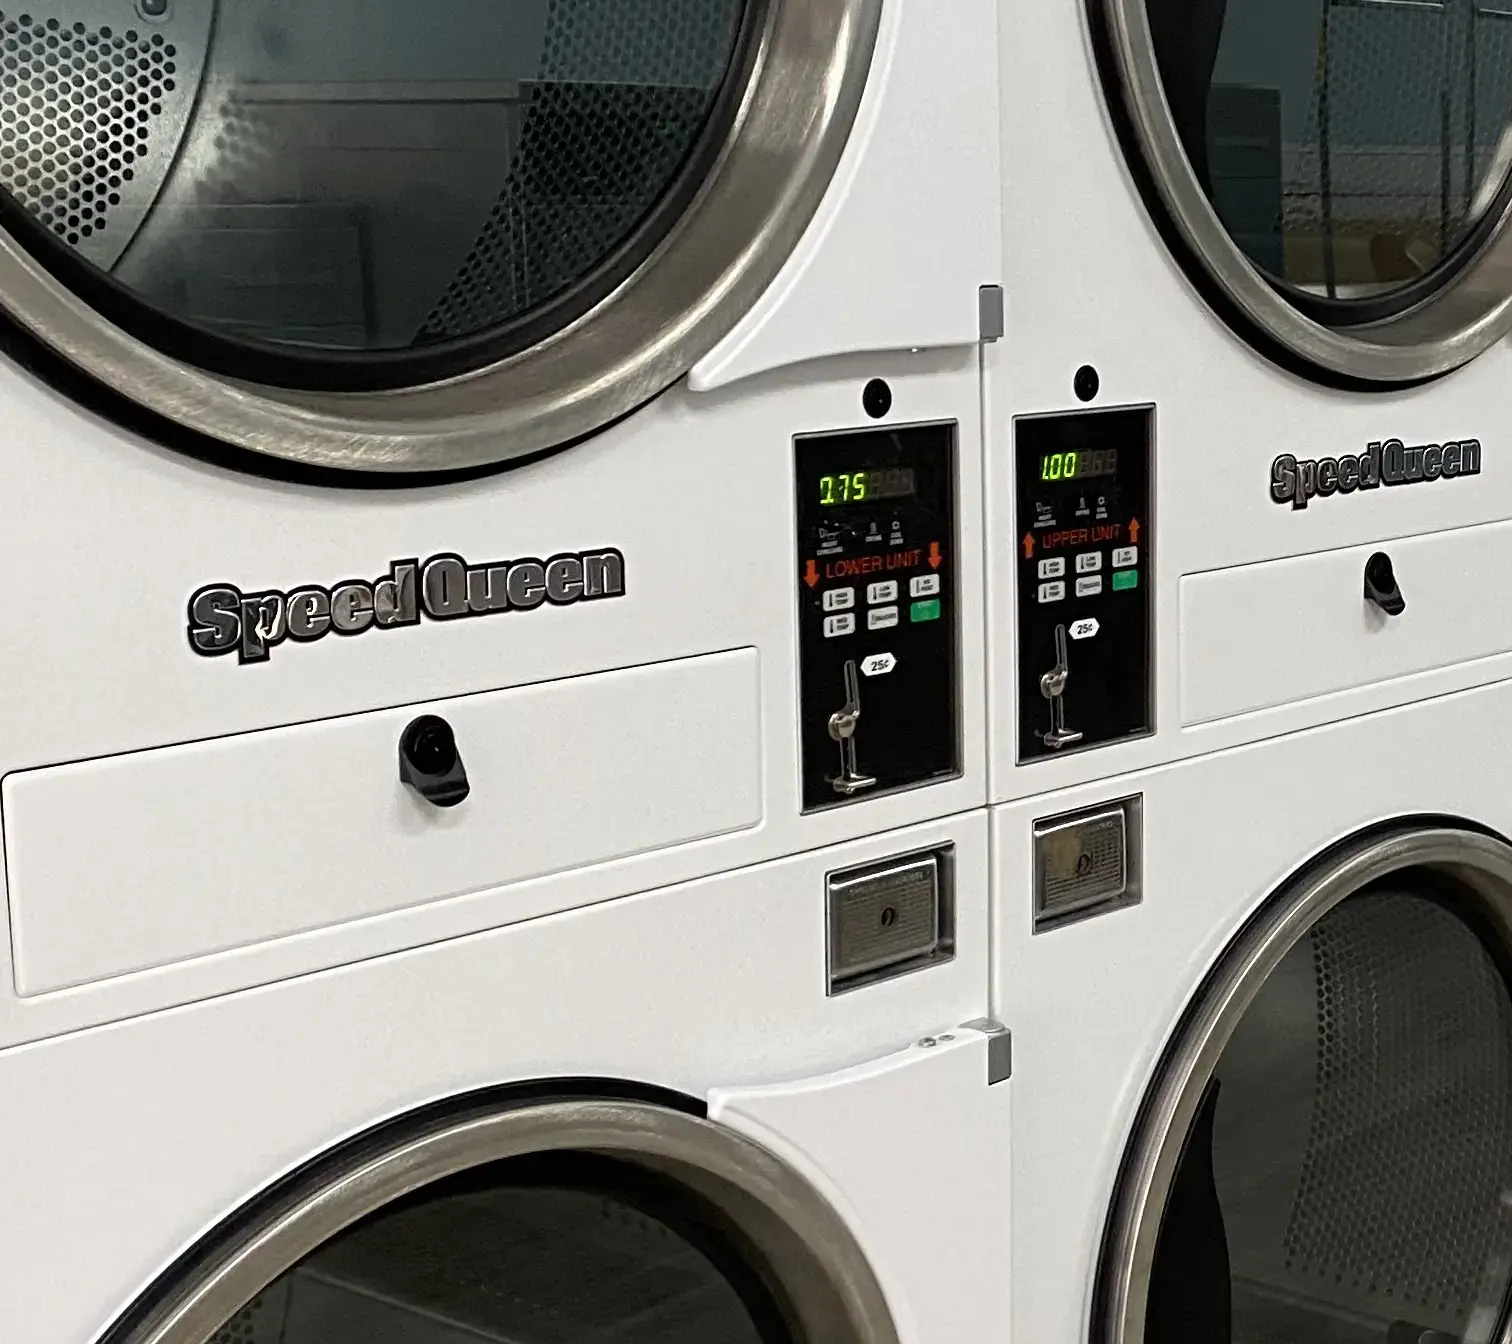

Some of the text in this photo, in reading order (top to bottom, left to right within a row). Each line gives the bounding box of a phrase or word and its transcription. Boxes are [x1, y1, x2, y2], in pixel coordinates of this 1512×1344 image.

[1042, 524, 1122, 549] UPPER UNIT
[825, 549, 924, 579] LOWER UNIT
[871, 659, 890, 672] 25¢
